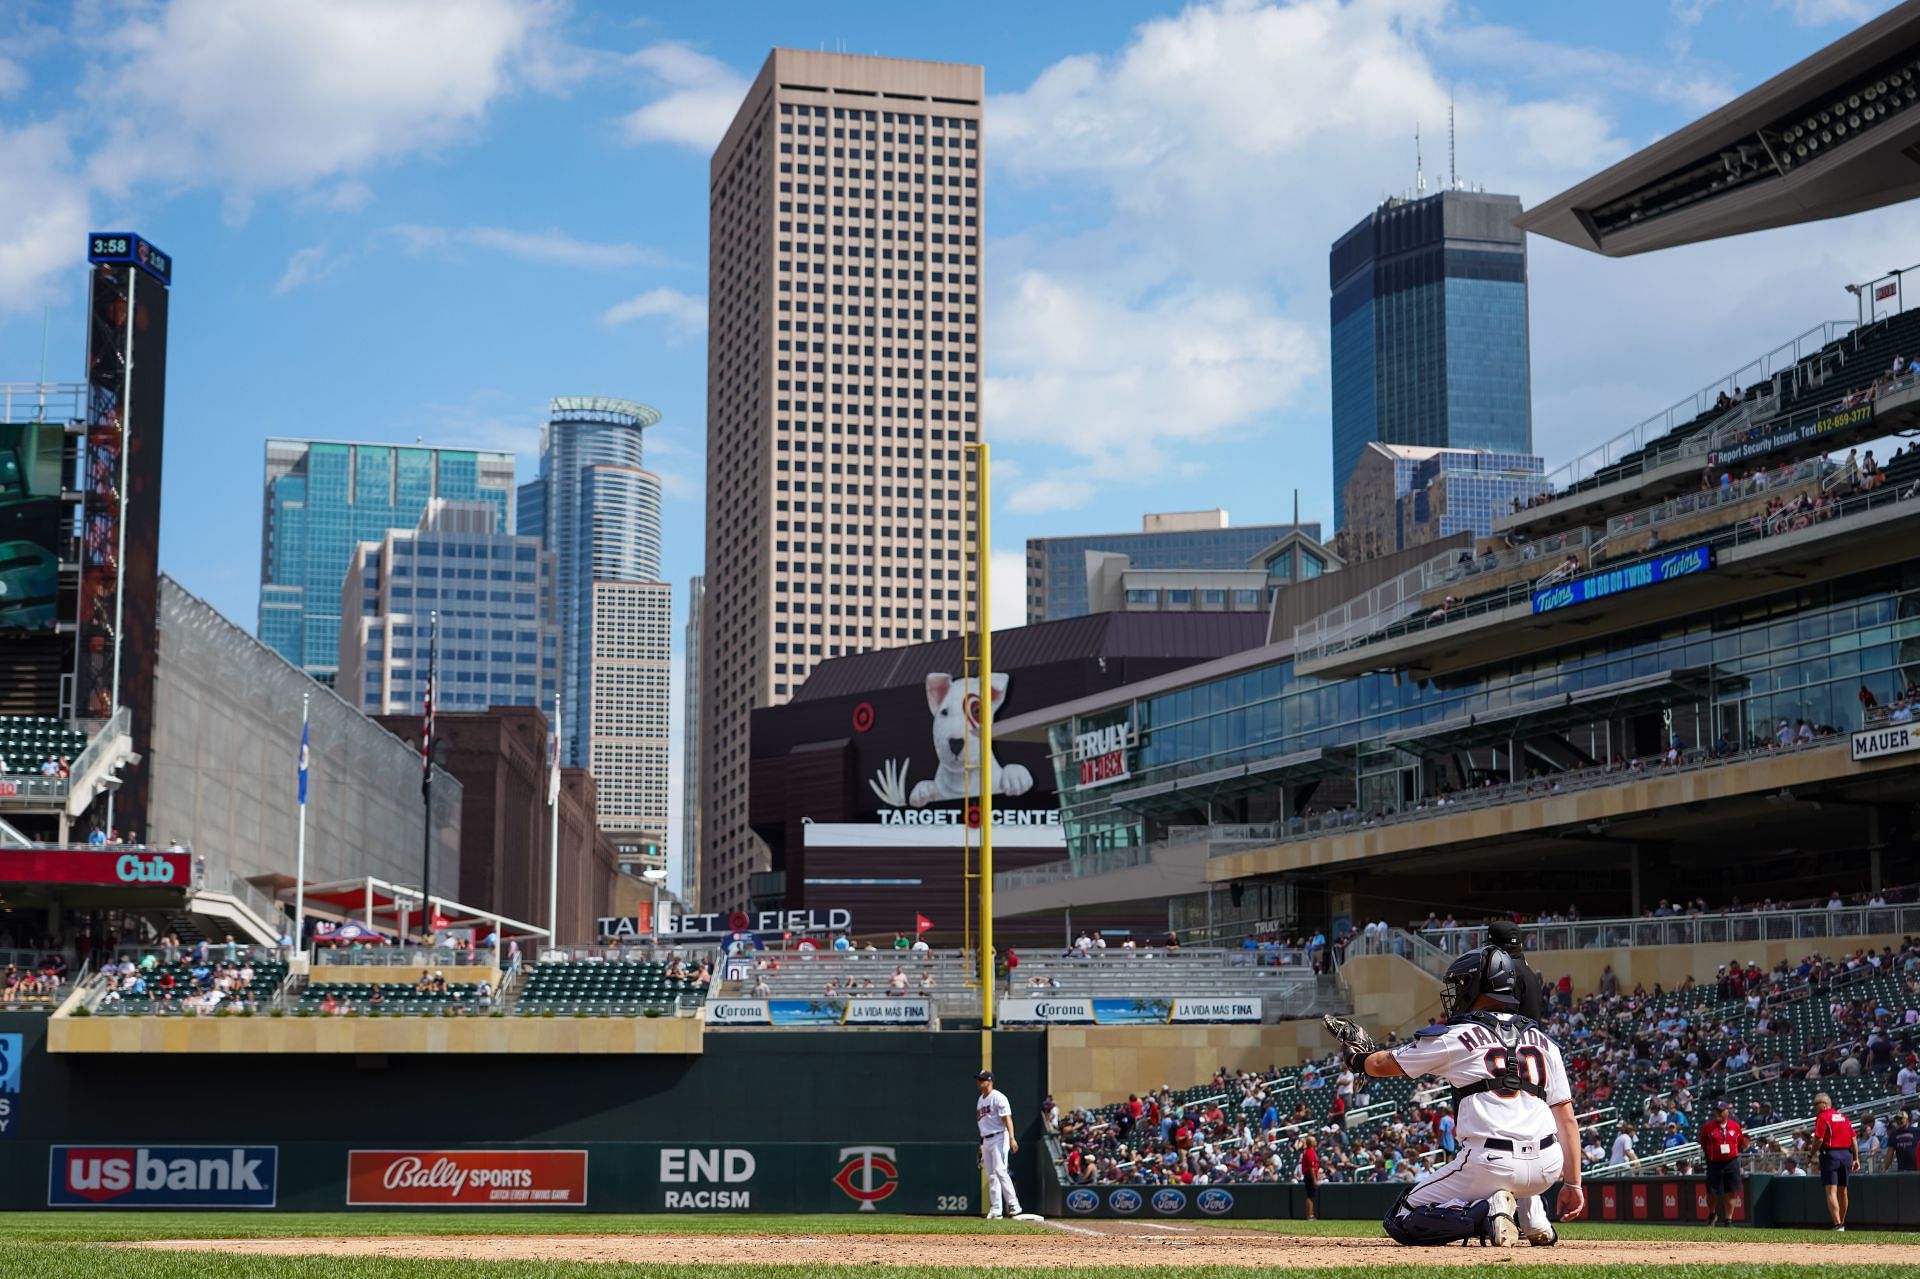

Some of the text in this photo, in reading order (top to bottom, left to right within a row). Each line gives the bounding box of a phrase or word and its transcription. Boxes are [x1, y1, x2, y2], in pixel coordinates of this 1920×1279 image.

[94, 239, 126, 253] 3:58
[1718, 447, 1742, 463] Report
[1743, 438, 1772, 456] Security
[1801, 424, 1816, 438] Text
[1537, 584, 1574, 612] Twins
[1624, 563, 1652, 590] TWINS
[1661, 550, 1702, 580] Twins
[1075, 722, 1130, 760] TRULY
[1855, 729, 1909, 755] MAUER
[877, 809, 962, 825] TARGET
[116, 854, 175, 883] Cub
[598, 912, 719, 936] TAGET
[758, 908, 851, 931] FIELD
[1255, 920, 1279, 935] TRULY
[714, 1003, 762, 1018] Corona
[853, 1006, 863, 1017] LA
[865, 1006, 883, 1017] VIDA
[905, 1006, 925, 1017] FINA
[1035, 1002, 1084, 1018] Corona
[1179, 1005, 1190, 1016] LA
[1191, 1005, 1210, 1016] VIDA
[1232, 1004, 1253, 1016] FINA
[660, 1149, 756, 1183] END
[383, 1156, 532, 1197] Bally SPORTS
[665, 1191, 750, 1208] RACISM
[937, 1196, 968, 1211] 328
[1073, 1192, 1093, 1209] Ford
[1115, 1192, 1135, 1209] Ford
[1158, 1192, 1179, 1209] Ford
[1204, 1192, 1226, 1209] Ford
